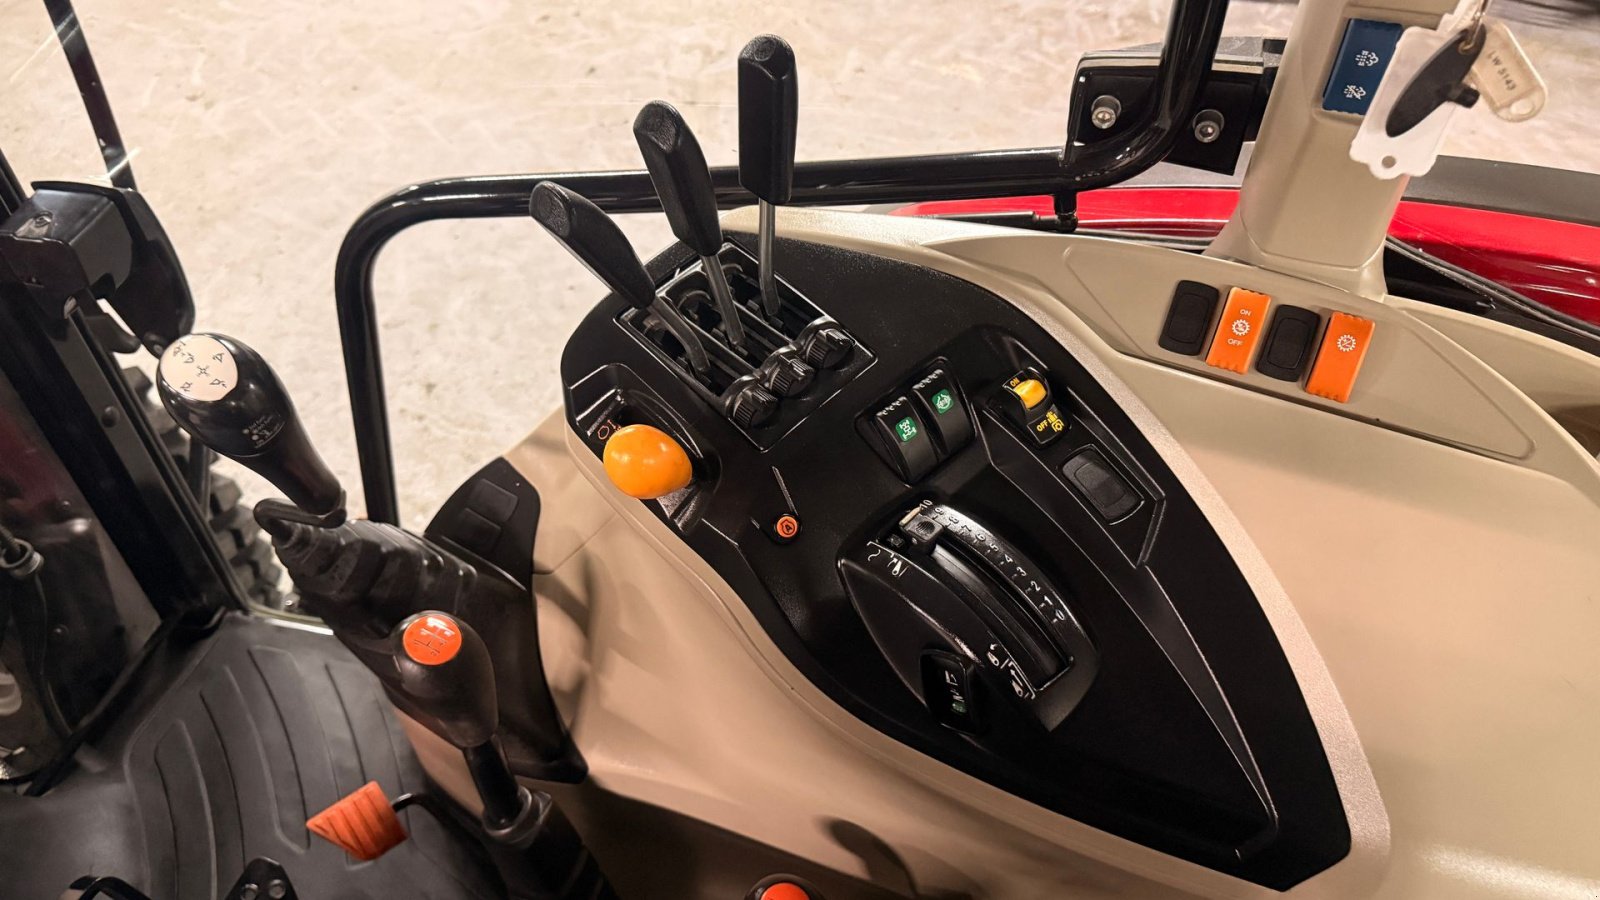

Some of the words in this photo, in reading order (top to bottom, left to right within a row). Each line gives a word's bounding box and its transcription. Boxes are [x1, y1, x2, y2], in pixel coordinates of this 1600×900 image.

[1240, 308, 1252, 316] ON
[1227, 338, 1243, 346] OFF
[1009, 377, 1020, 387] ON
[1036, 419, 1049, 432] OFF
[920, 499, 933, 509] 10
[960, 524, 972, 533] 7
[989, 542, 999, 552] 5
[1004, 553, 1014, 563] 4
[1016, 566, 1027, 577] 3
[1030, 580, 1041, 592] 2
[1044, 595, 1053, 606] 1
[1055, 609, 1065, 621] 0
